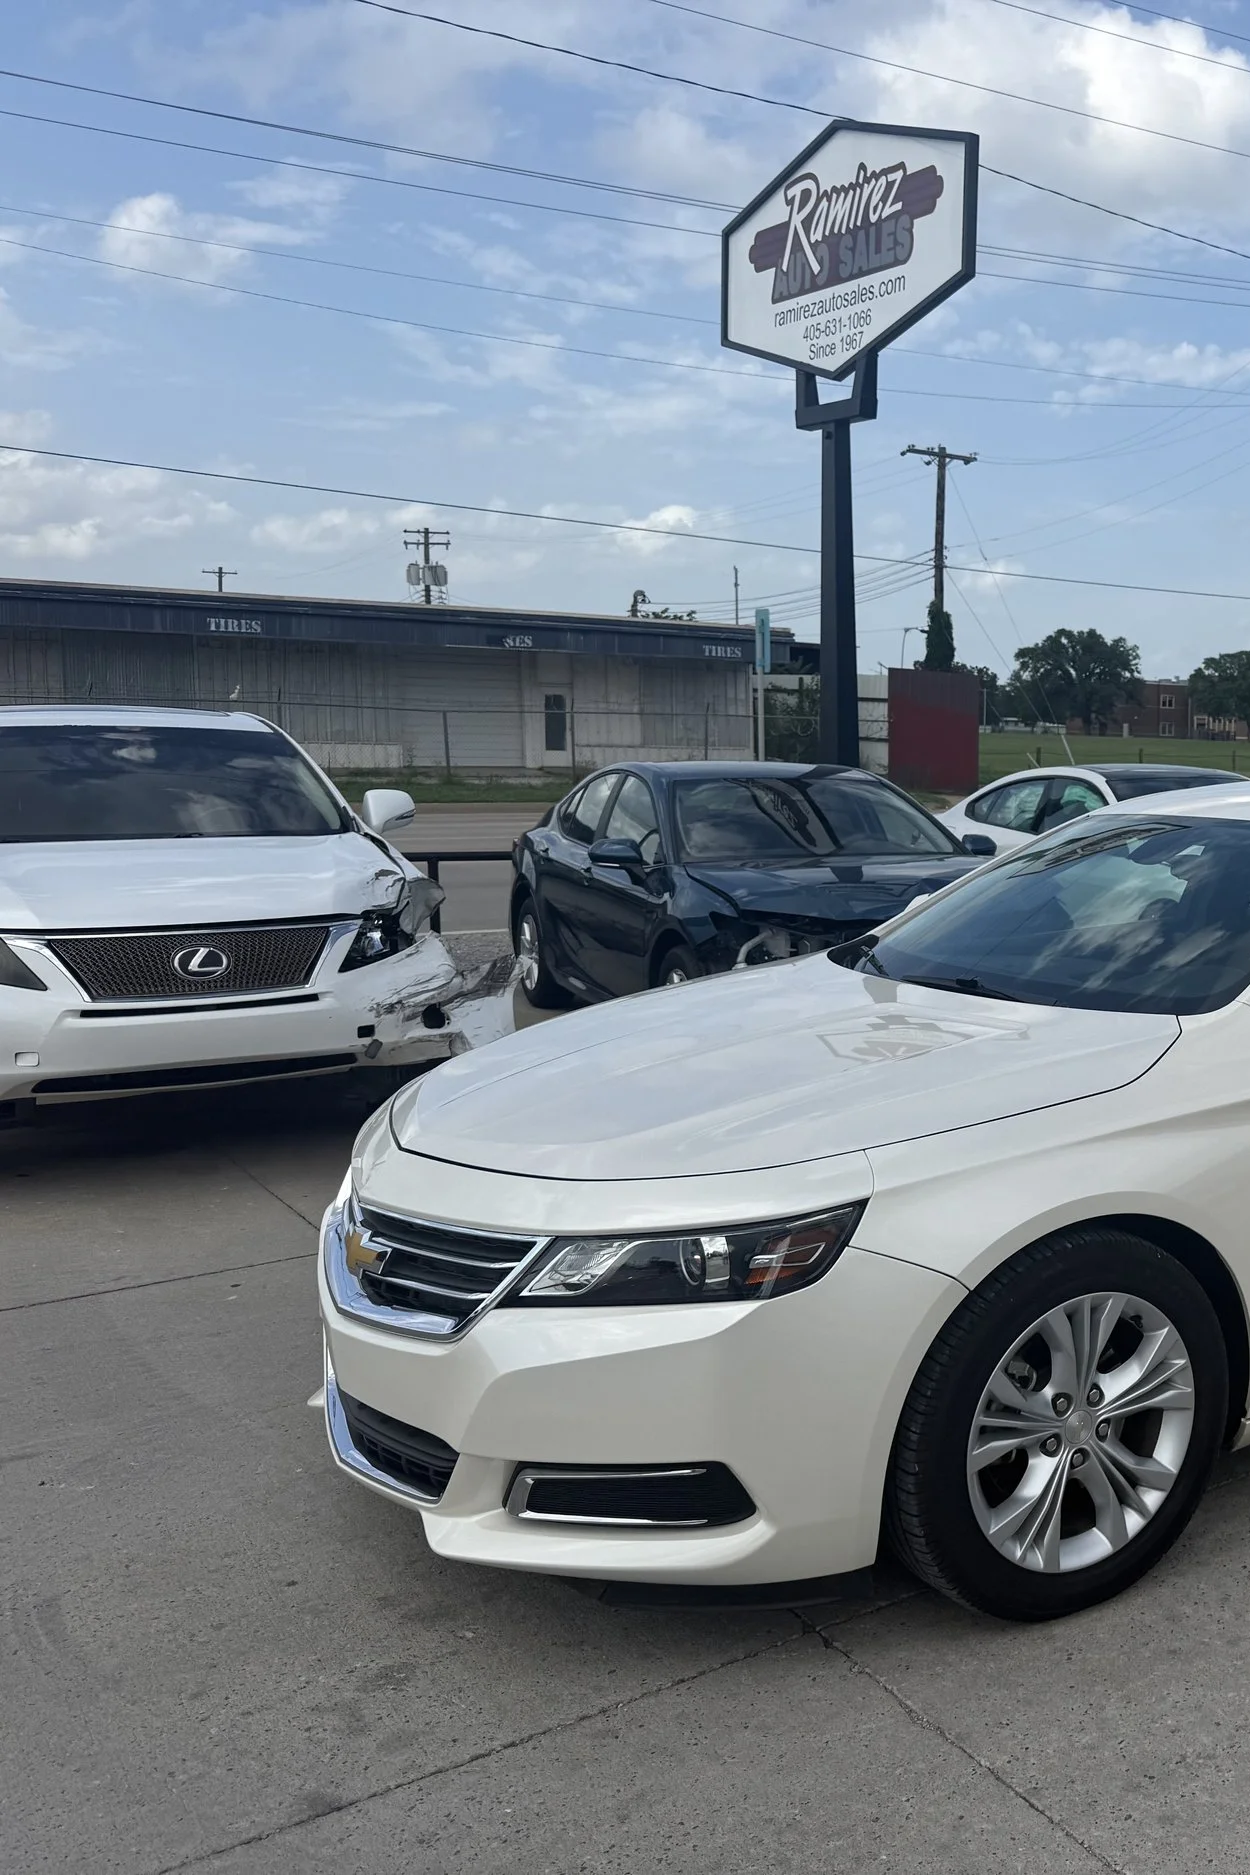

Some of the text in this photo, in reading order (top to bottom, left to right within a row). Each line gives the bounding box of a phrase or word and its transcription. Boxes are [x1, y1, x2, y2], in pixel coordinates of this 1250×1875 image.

[782, 167, 904, 276] Ramirez
[840, 214, 911, 278] SALES
[774, 275, 906, 328] ramirezautosales.com
[803, 308, 872, 342] 405-631-1066
[808, 331, 864, 361] Since 1967
[206, 617, 262, 633] TIRES
[703, 645, 742, 658] TIRES
